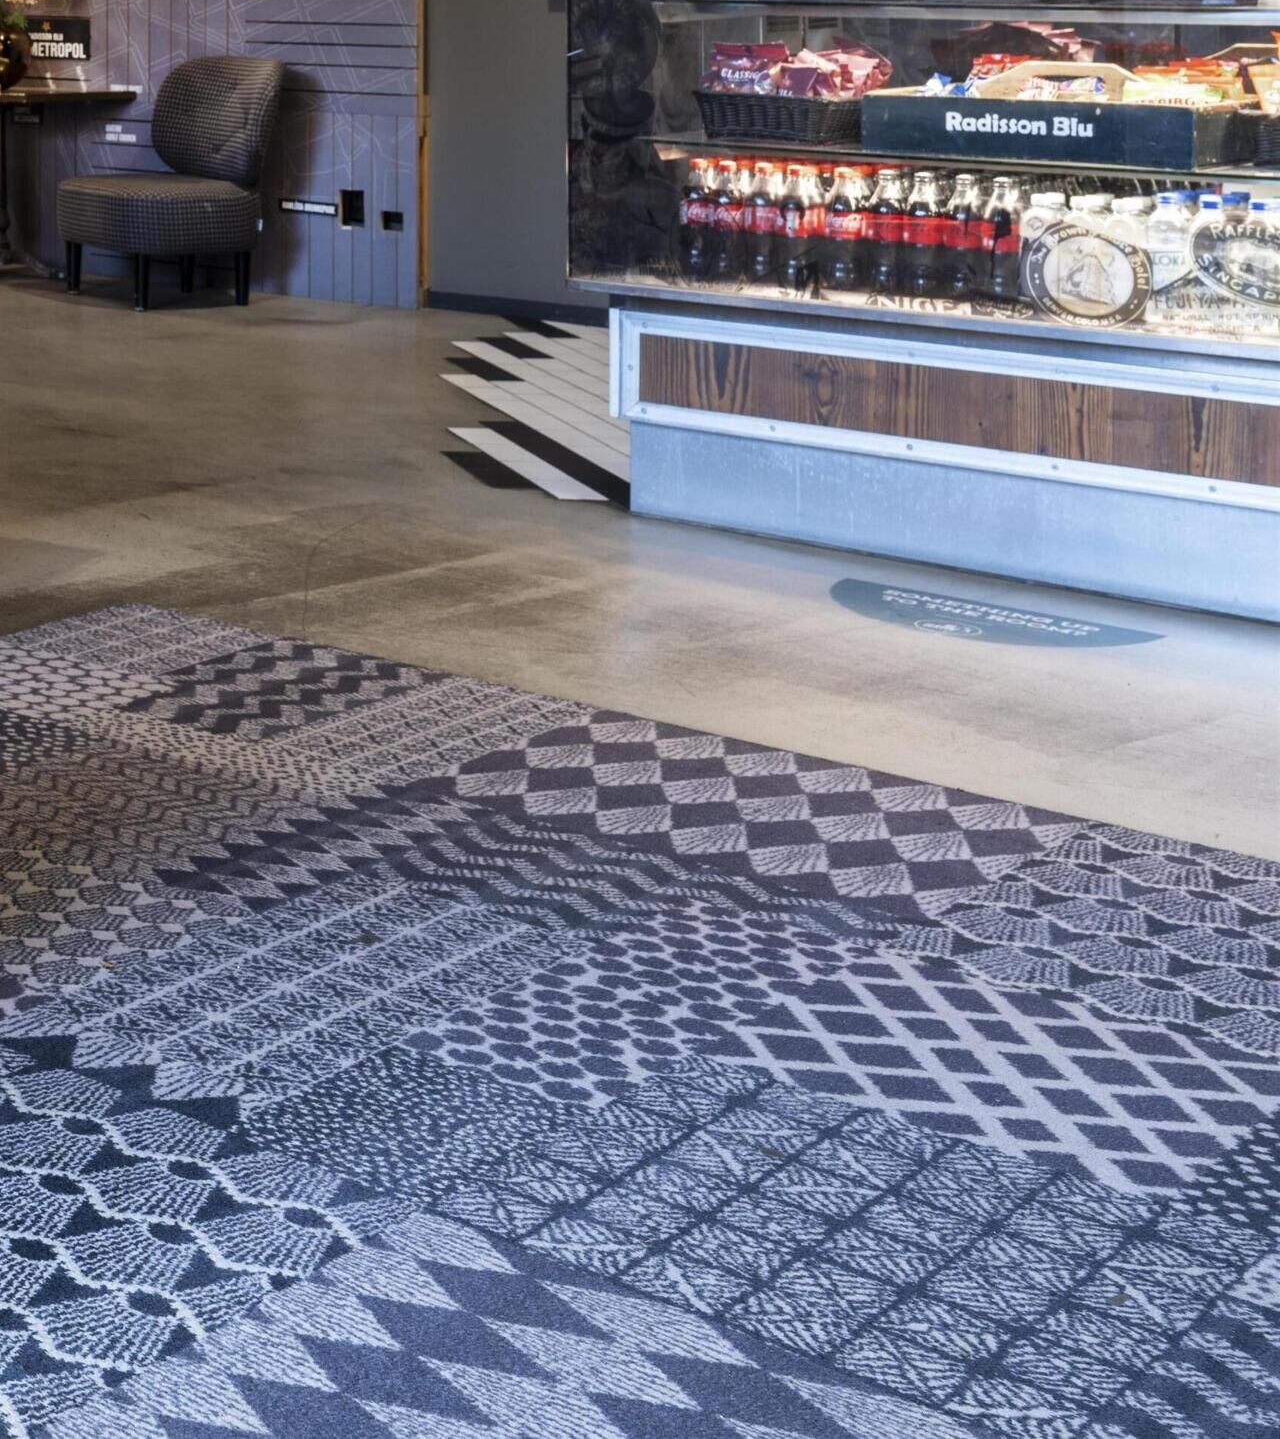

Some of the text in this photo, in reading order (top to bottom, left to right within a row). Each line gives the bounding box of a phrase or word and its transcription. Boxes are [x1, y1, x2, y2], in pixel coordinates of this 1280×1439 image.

[945, 111, 1094, 138] Radisson Blu
[882, 595, 918, 605] TO
[926, 602, 982, 618] THE
[882, 589, 1101, 632] SOMETHING UP
